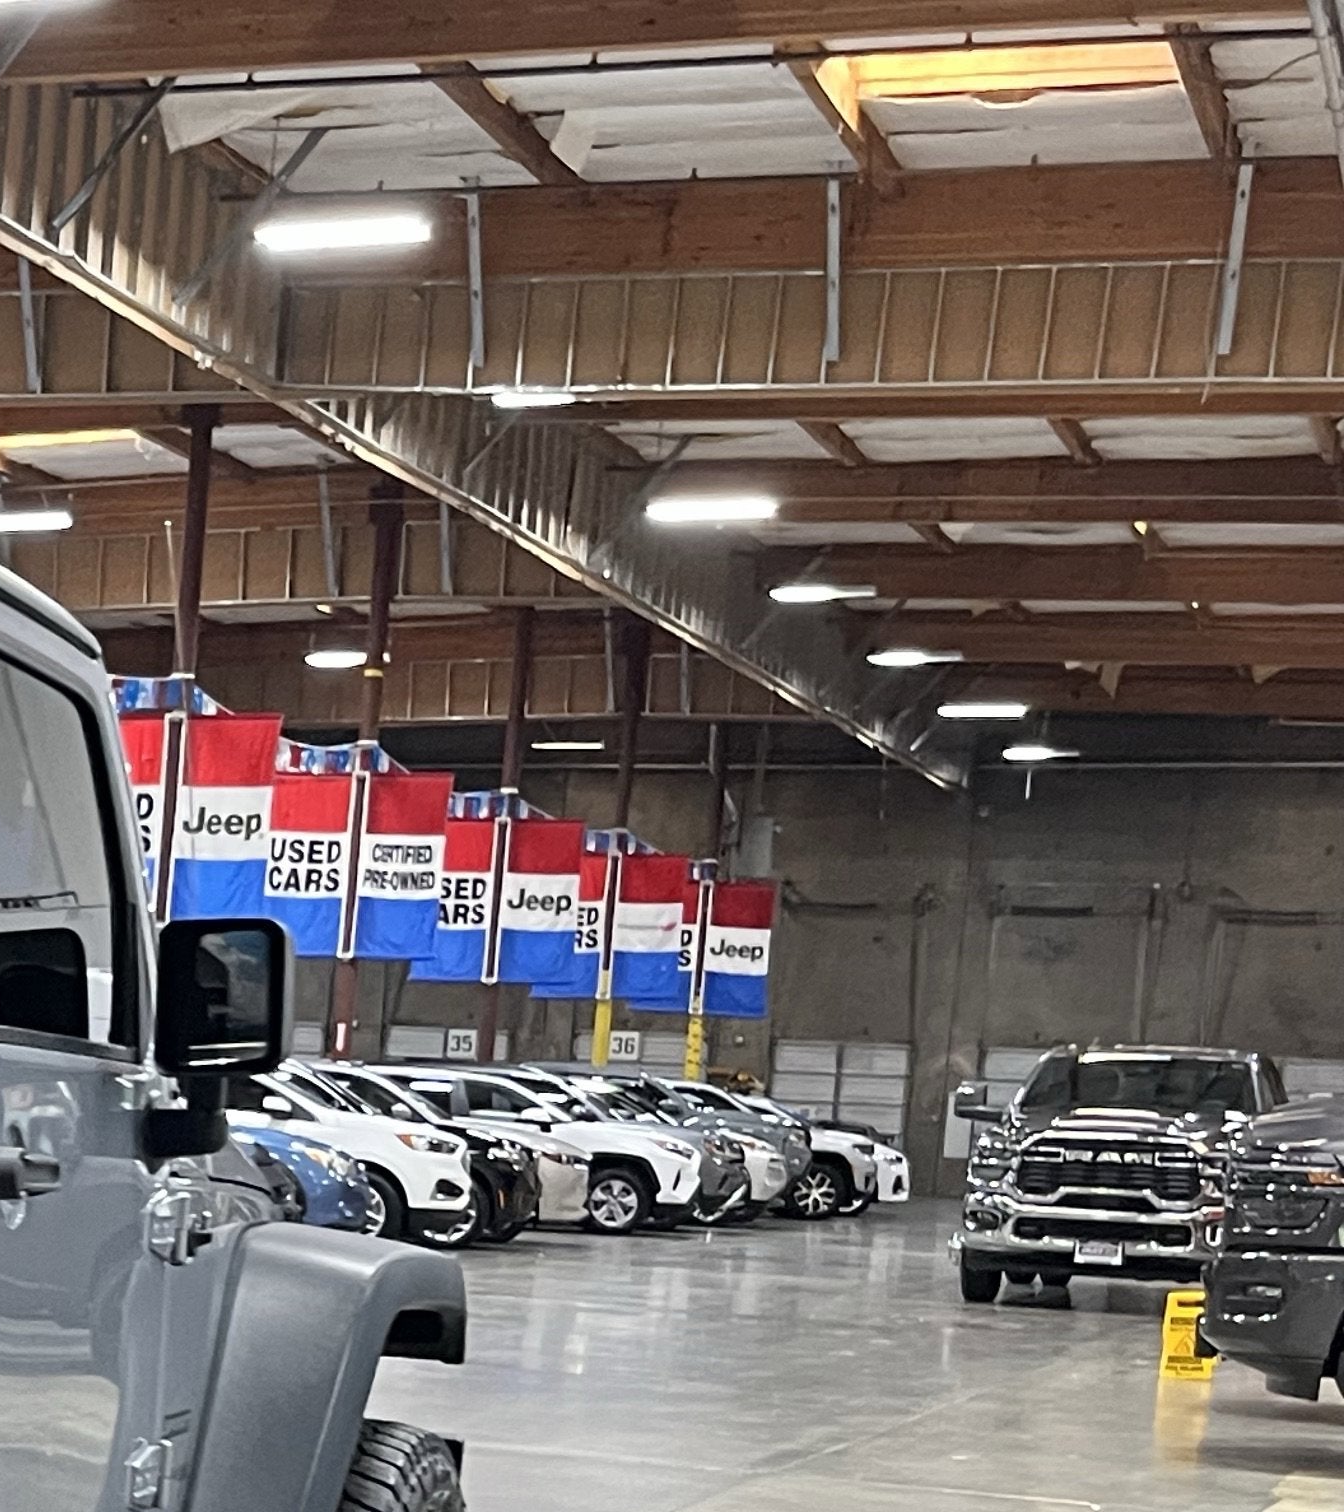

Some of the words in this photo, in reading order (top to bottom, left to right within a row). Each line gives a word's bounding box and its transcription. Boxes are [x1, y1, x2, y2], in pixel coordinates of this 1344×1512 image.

[182, 807, 262, 841] Jeep
[271, 838, 341, 864] USED
[372, 843, 433, 864] CERTIFIED
[269, 866, 339, 892] CARS
[362, 869, 435, 891] PRE-OWNED
[441, 877, 486, 899] SED
[506, 888, 572, 916] Jeep
[438, 903, 484, 924] ARS
[710, 939, 764, 962] Jeep
[450, 1035, 472, 1052] 35
[612, 1036, 635, 1054] 36
